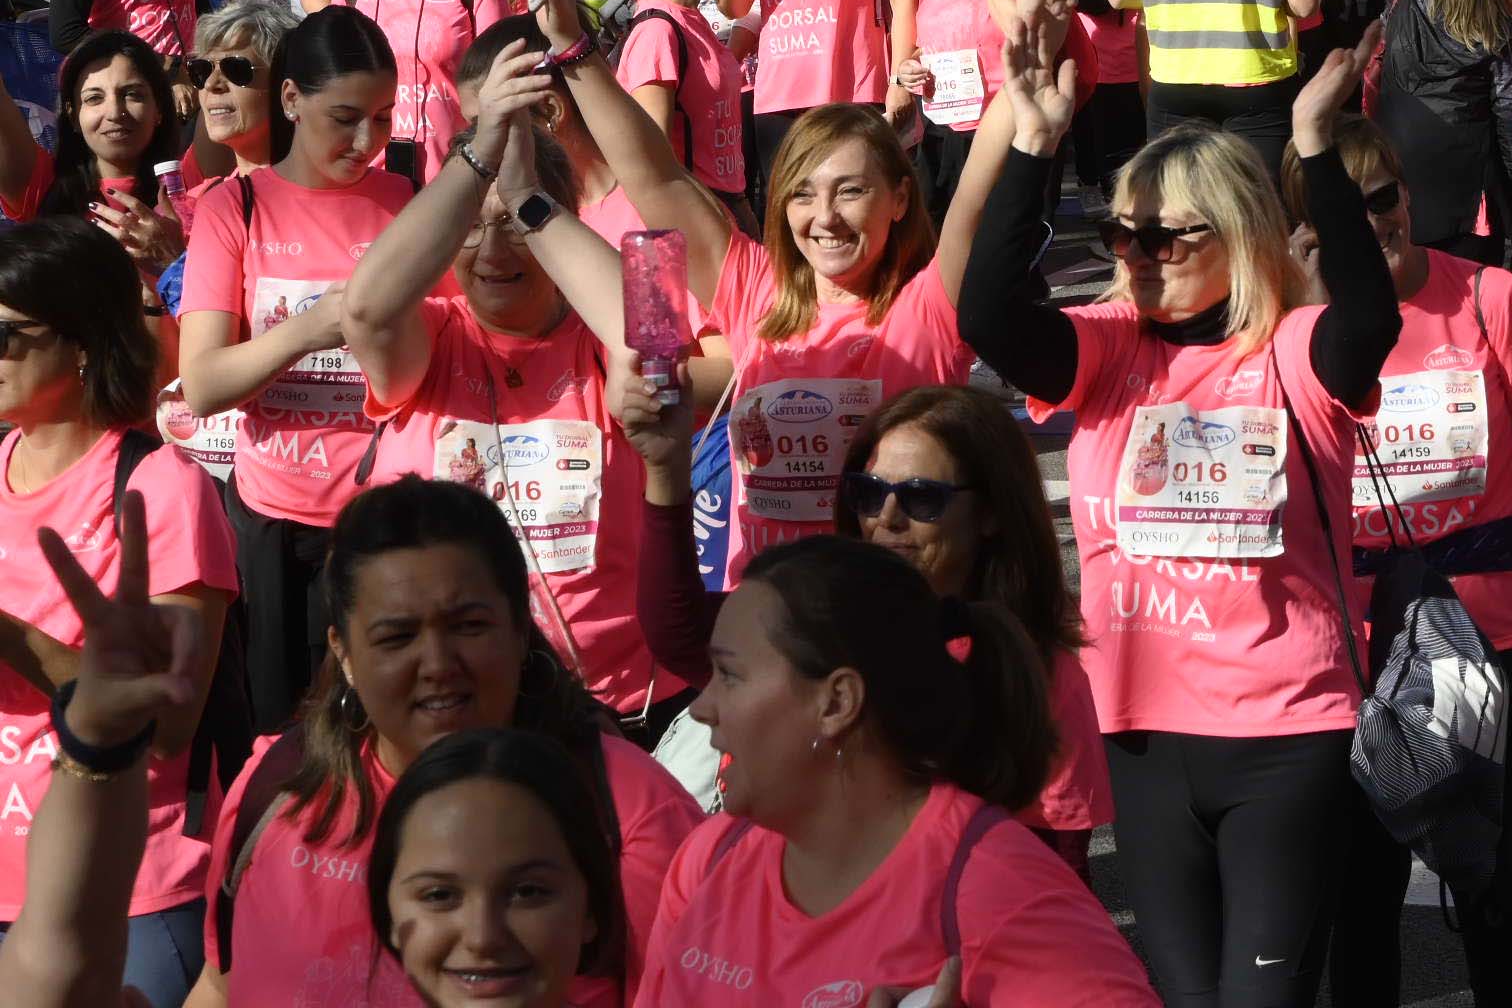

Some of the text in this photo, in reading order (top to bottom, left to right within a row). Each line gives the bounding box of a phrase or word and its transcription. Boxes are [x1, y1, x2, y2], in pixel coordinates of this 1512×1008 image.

[769, 6, 837, 32] DORSAL
[769, 34, 821, 56] SUMA
[311, 356, 342, 369] 7198
[337, 375, 366, 383] MUJER
[1446, 386, 1473, 394] SUMA
[839, 396, 870, 405] SUMA
[774, 405, 827, 416] ASTURIANA
[1242, 425, 1275, 435] SUMA
[1384, 423, 1435, 443] 016
[557, 440, 589, 449] SUMA
[777, 435, 829, 454] 016
[1392, 447, 1431, 460] 14159
[785, 461, 825, 473] 14154
[1172, 462, 1228, 483] 016
[1397, 465, 1408, 473] DE
[1410, 464, 1422, 472] LA
[1423, 462, 1453, 472] MUJER
[790, 479, 803, 487] DE
[804, 479, 815, 487] LA
[1178, 490, 1219, 504] 14156
[754, 497, 792, 510] OYSHO
[1136, 510, 1180, 520] CARRERA
[1181, 511, 1194, 520] DE
[1195, 511, 1208, 521] LA
[1210, 511, 1243, 521] MUJER
[530, 525, 586, 537] MUJER 2023
[1132, 530, 1180, 543] OYSHO
[541, 544, 591, 560] Santander
[1191, 631, 1216, 642] 2023
[681, 946, 752, 990] OYSHO
